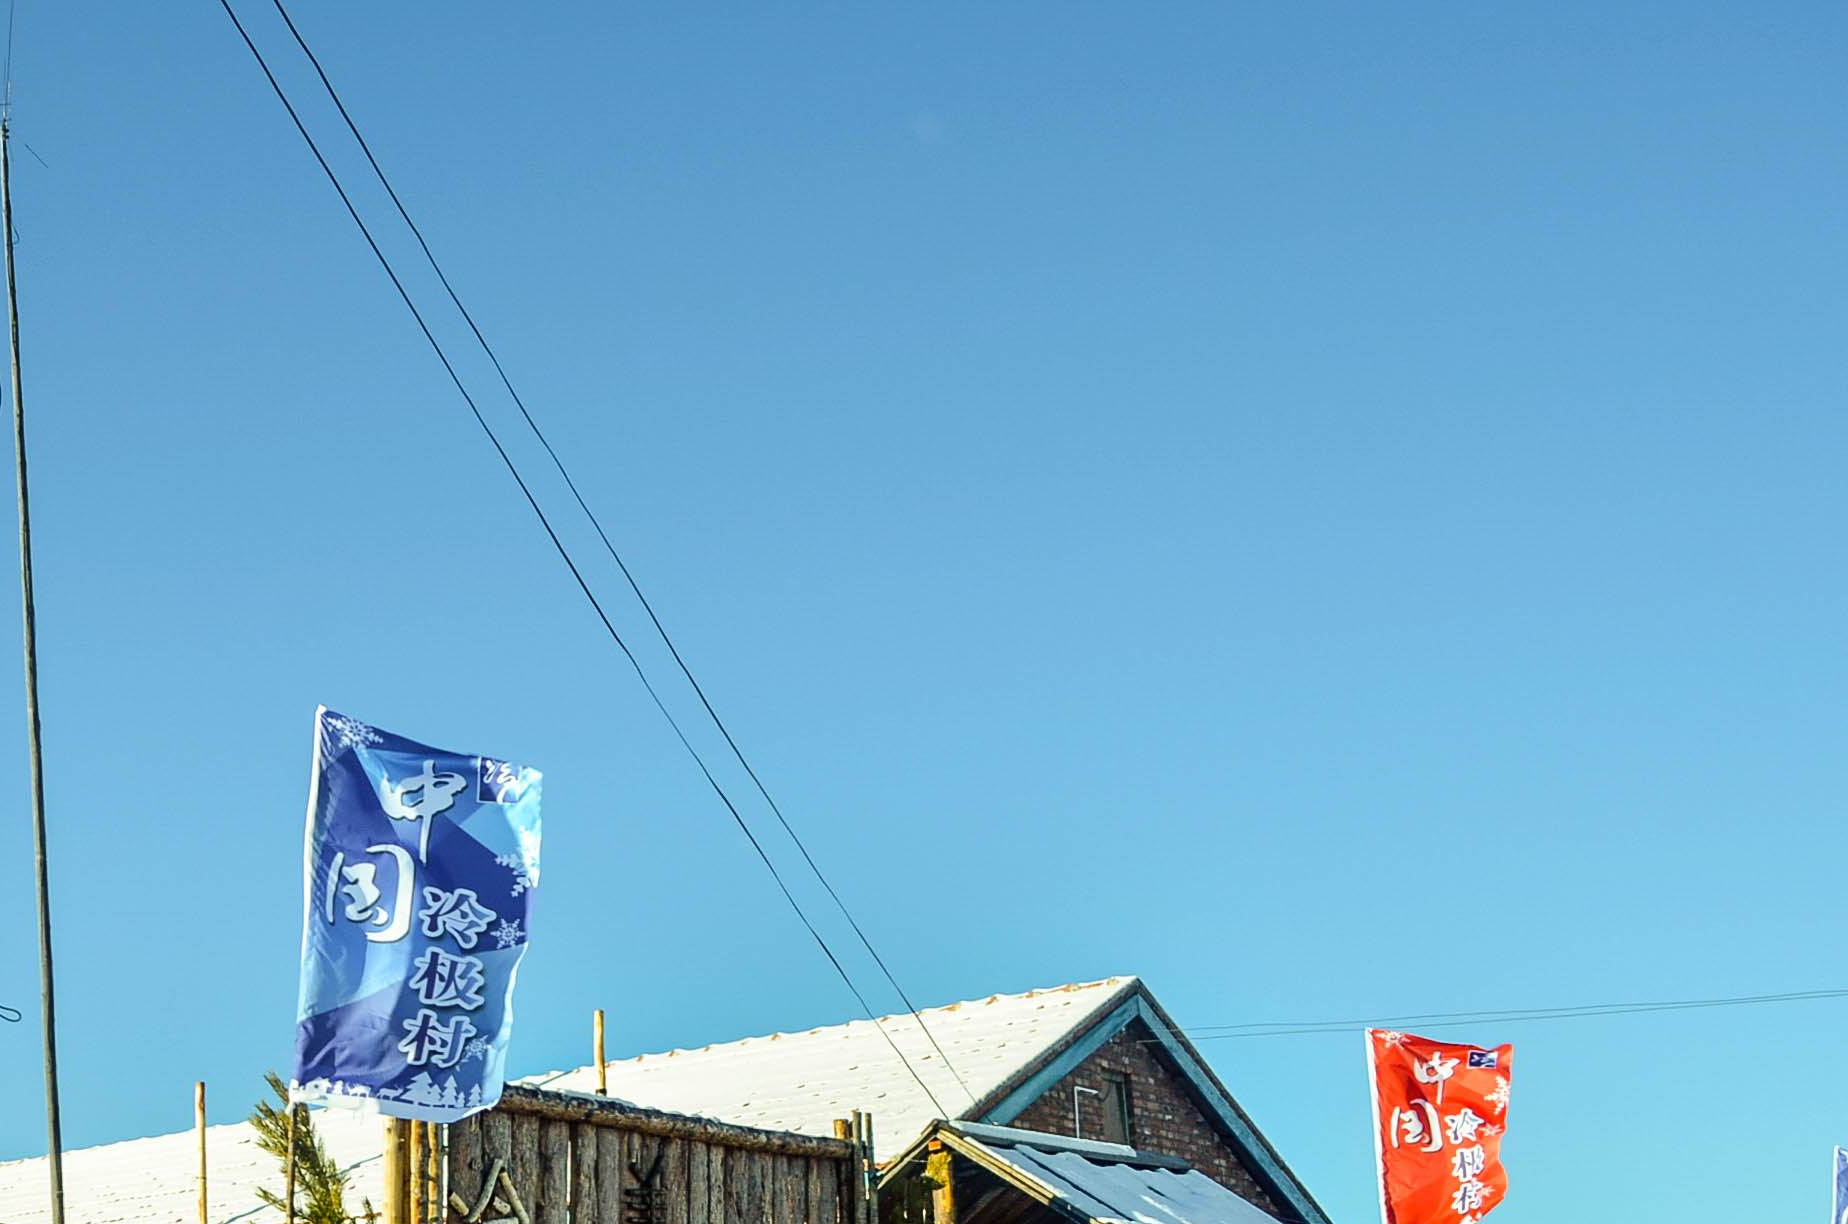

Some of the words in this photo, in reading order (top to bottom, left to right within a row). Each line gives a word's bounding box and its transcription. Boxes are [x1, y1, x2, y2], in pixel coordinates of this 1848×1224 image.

[325, 760, 468, 943] 中国
[398, 886, 497, 1069] 冷极村
[1390, 1051, 1460, 1153] 中国
[1444, 1107, 1486, 1215] 冷极村
